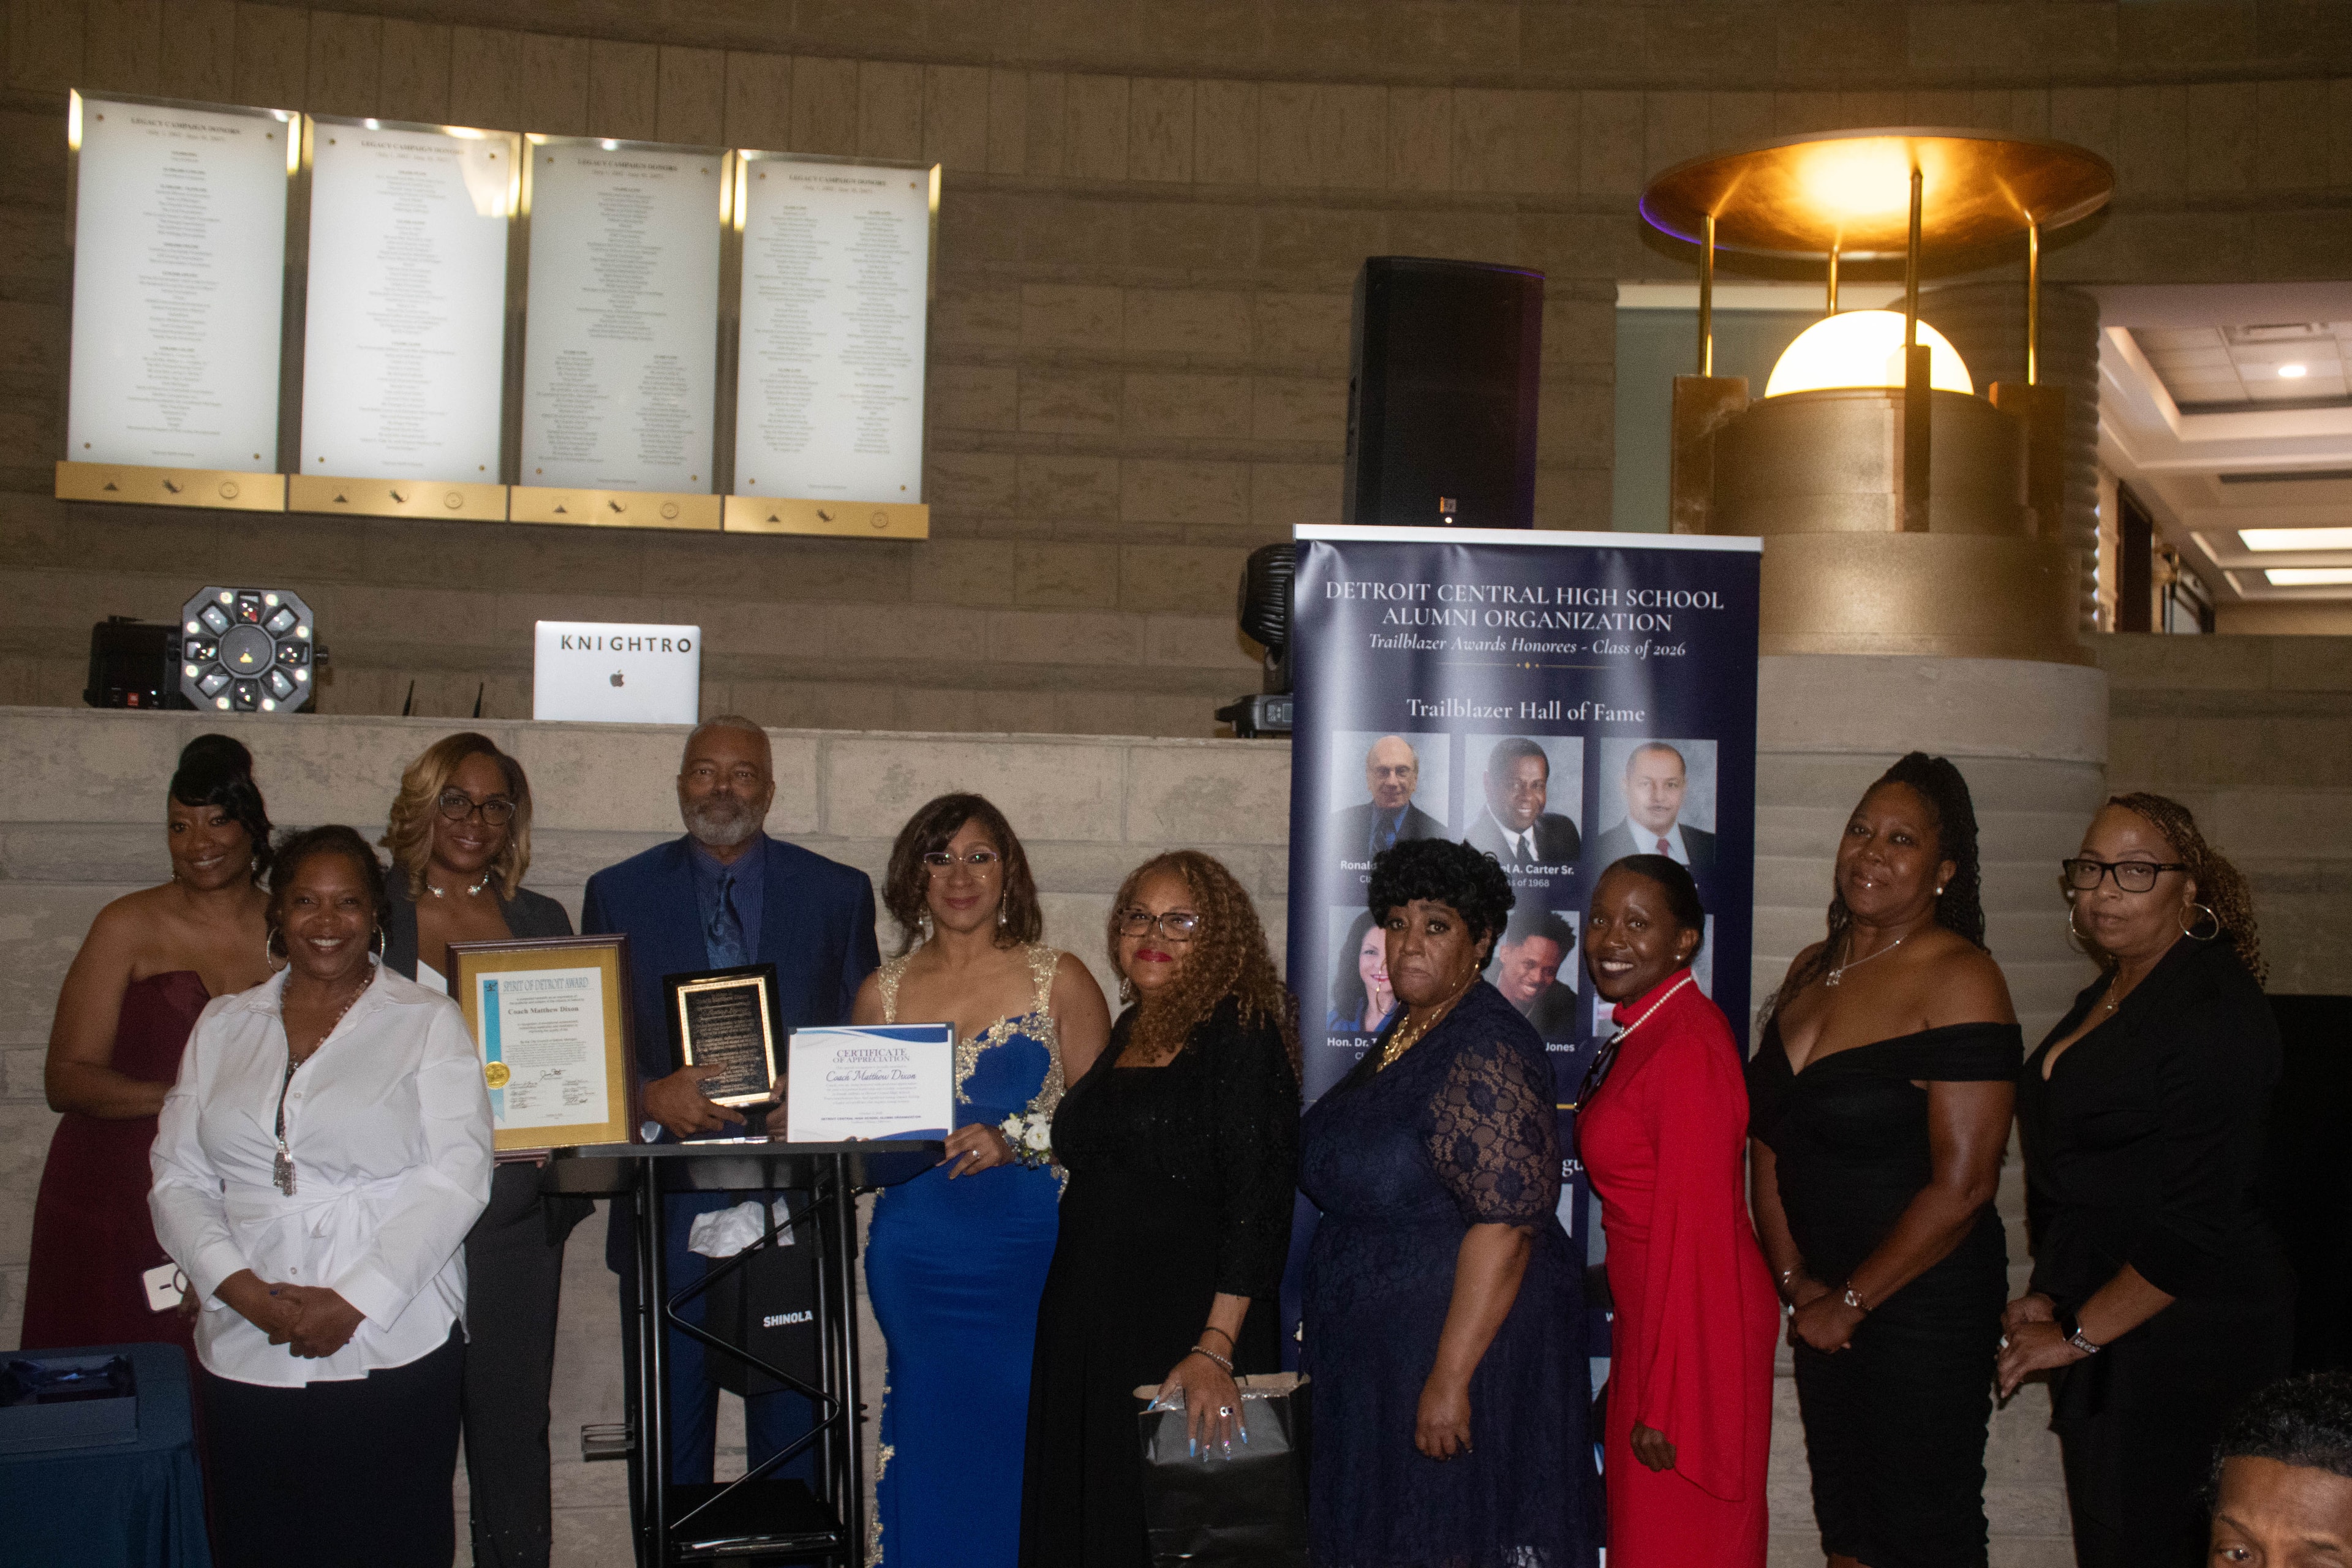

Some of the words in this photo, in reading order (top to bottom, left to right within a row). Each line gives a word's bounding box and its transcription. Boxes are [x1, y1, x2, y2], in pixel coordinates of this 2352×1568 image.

[1325, 581, 1431, 601] DETROIT
[1438, 584, 1550, 605] CENTRAL
[1556, 587, 1618, 606] HIGH
[1626, 589, 1724, 610] SCHOOL
[1382, 607, 1476, 626] ALUMNI
[1484, 609, 1673, 632] ORGANIZATION
[561, 635, 692, 653] KNIGHTRO
[1369, 633, 1446, 650] Trailblazer
[1451, 636, 1507, 652] Awards
[1512, 637, 1577, 654] Honorees
[1593, 639, 1630, 655] Class
[1635, 639, 1653, 660] of
[1653, 641, 1686, 656] 2026
[1406, 698, 1513, 719] Trailblazer
[1520, 700, 1561, 720] Hall
[1567, 701, 1591, 721] of
[1594, 703, 1646, 722] Fame
[1512, 864, 1523, 873] A.
[1526, 864, 1559, 875] Carter
[1561, 865, 1575, 875] Sr.
[1517, 878, 1526, 887] of
[1528, 879, 1550, 888] 1968
[503, 980, 524, 992] SPIRIT
[524, 979, 533, 990] OF
[535, 978, 564, 990] DETROIT
[566, 976, 589, 988] AWARD
[1327, 1037, 1352, 1047] Hon.
[1354, 1038, 1369, 1047] Dr.
[1545, 1042, 1575, 1052] Jones
[837, 1048, 907, 1057] CERTIFICATE
[826, 1071, 852, 1082] Coach
[852, 1069, 889, 1080] Matthew
[891, 1069, 916, 1080] Dixon
[763, 1310, 813, 1327] SHINOLA
